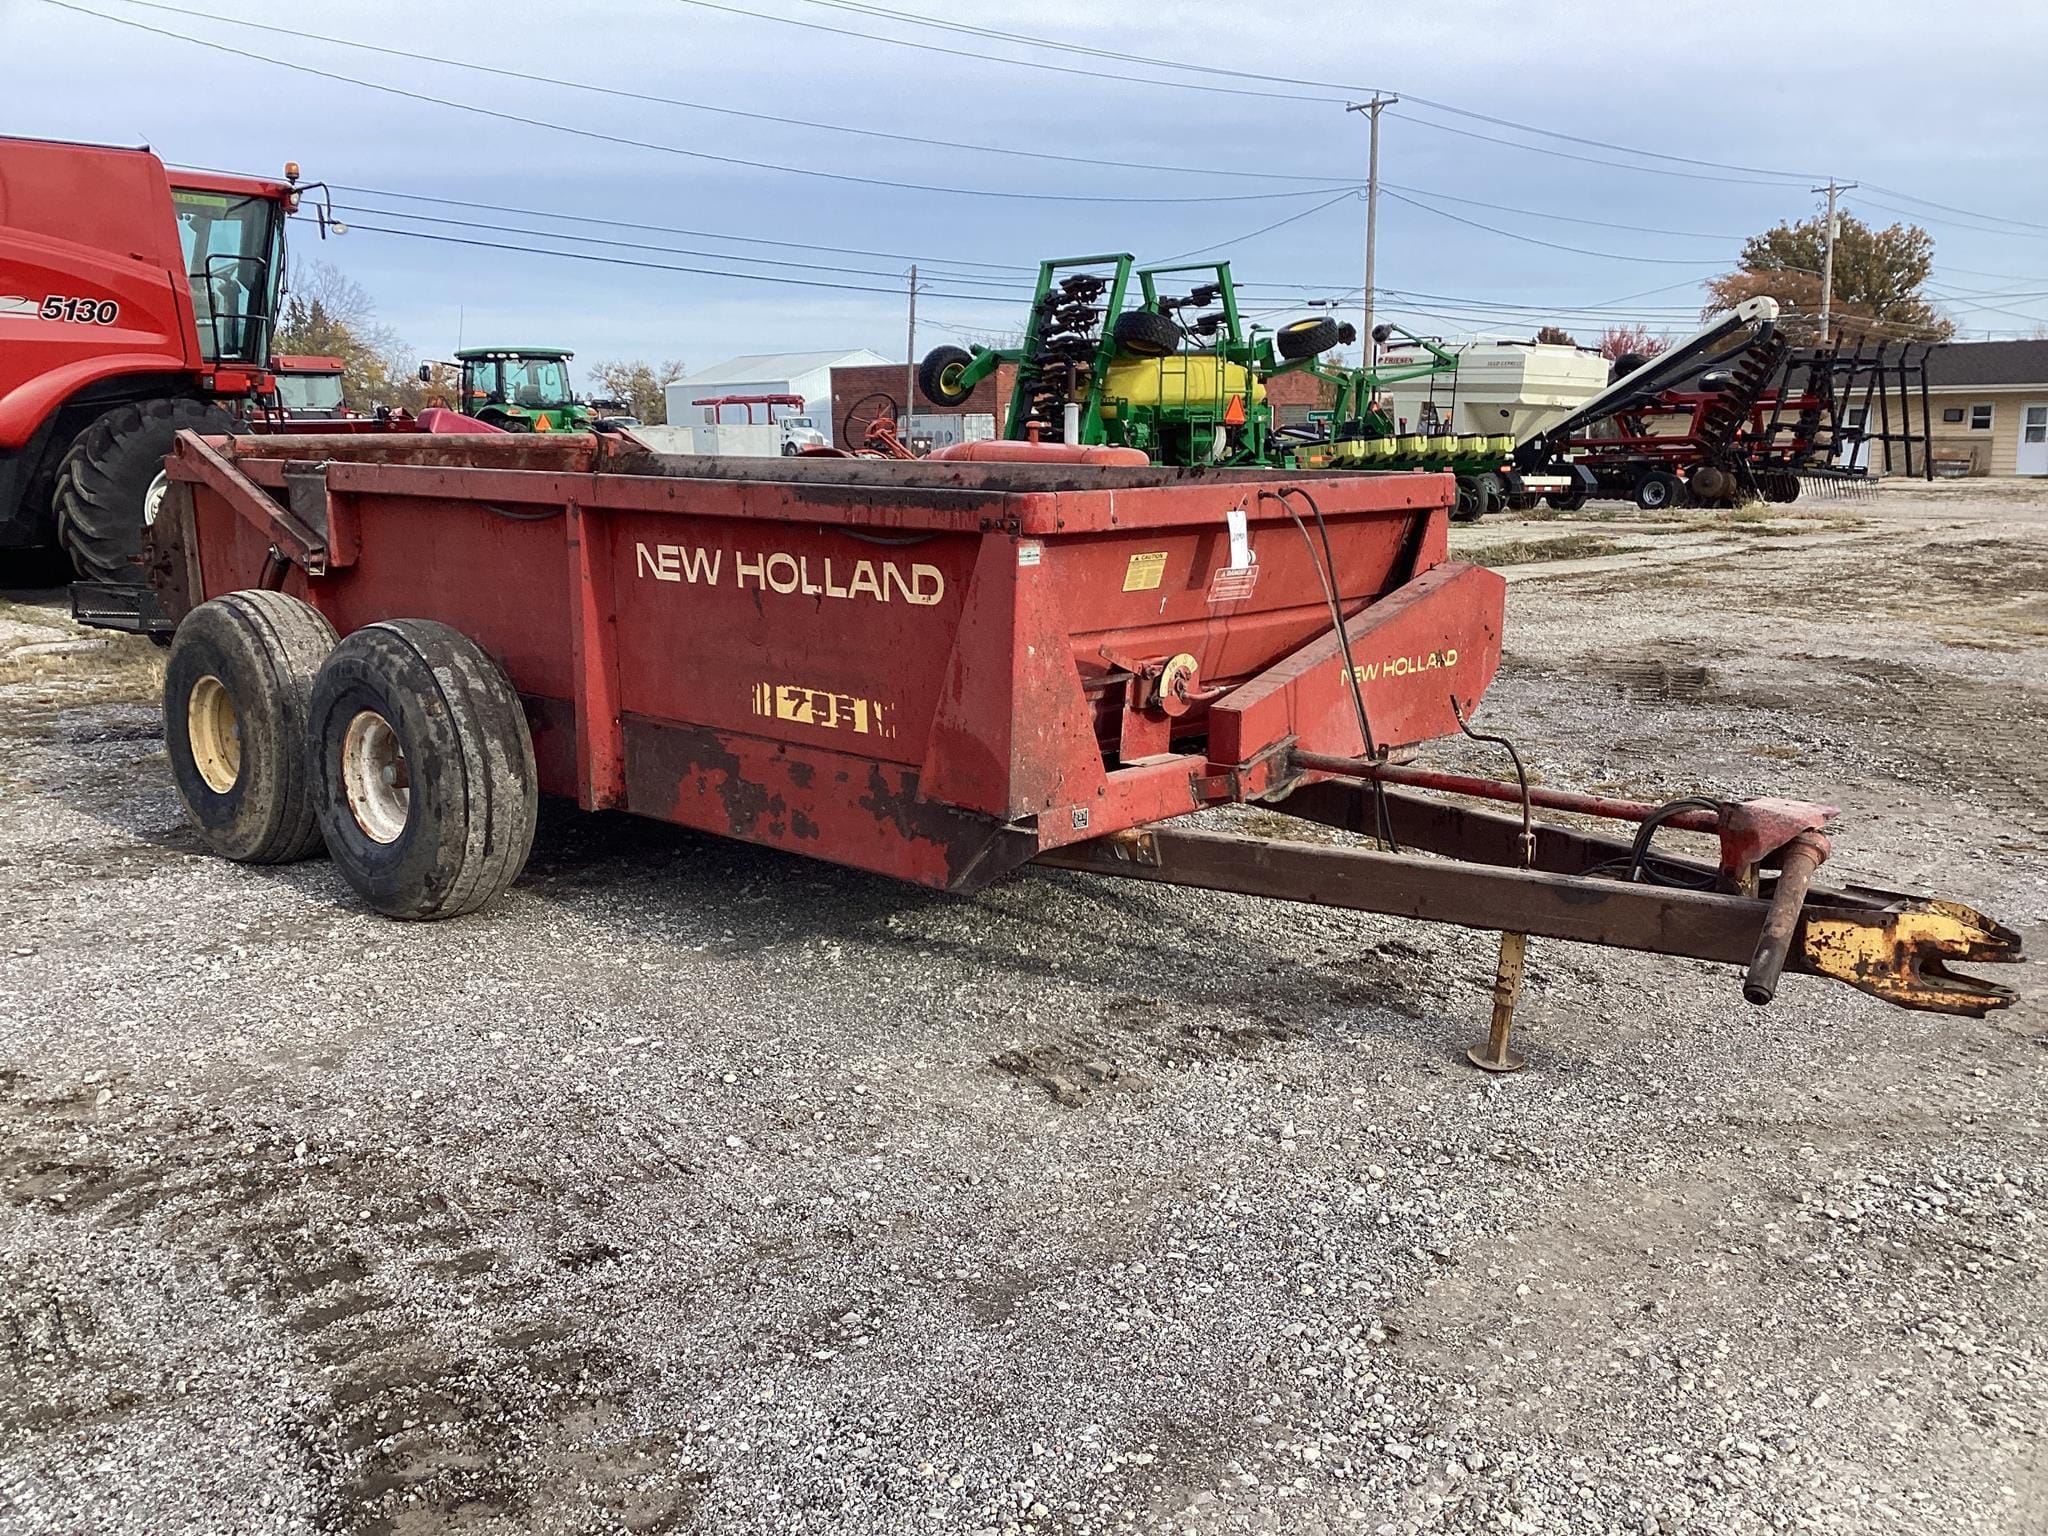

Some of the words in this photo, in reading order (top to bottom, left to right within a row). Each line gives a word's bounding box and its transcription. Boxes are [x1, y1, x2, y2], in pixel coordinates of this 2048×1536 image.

[40, 295, 119, 325] 5130
[636, 542, 722, 585] NEW
[736, 550, 945, 605] HOLLAND
[1383, 649, 1458, 678] HOLLAND
